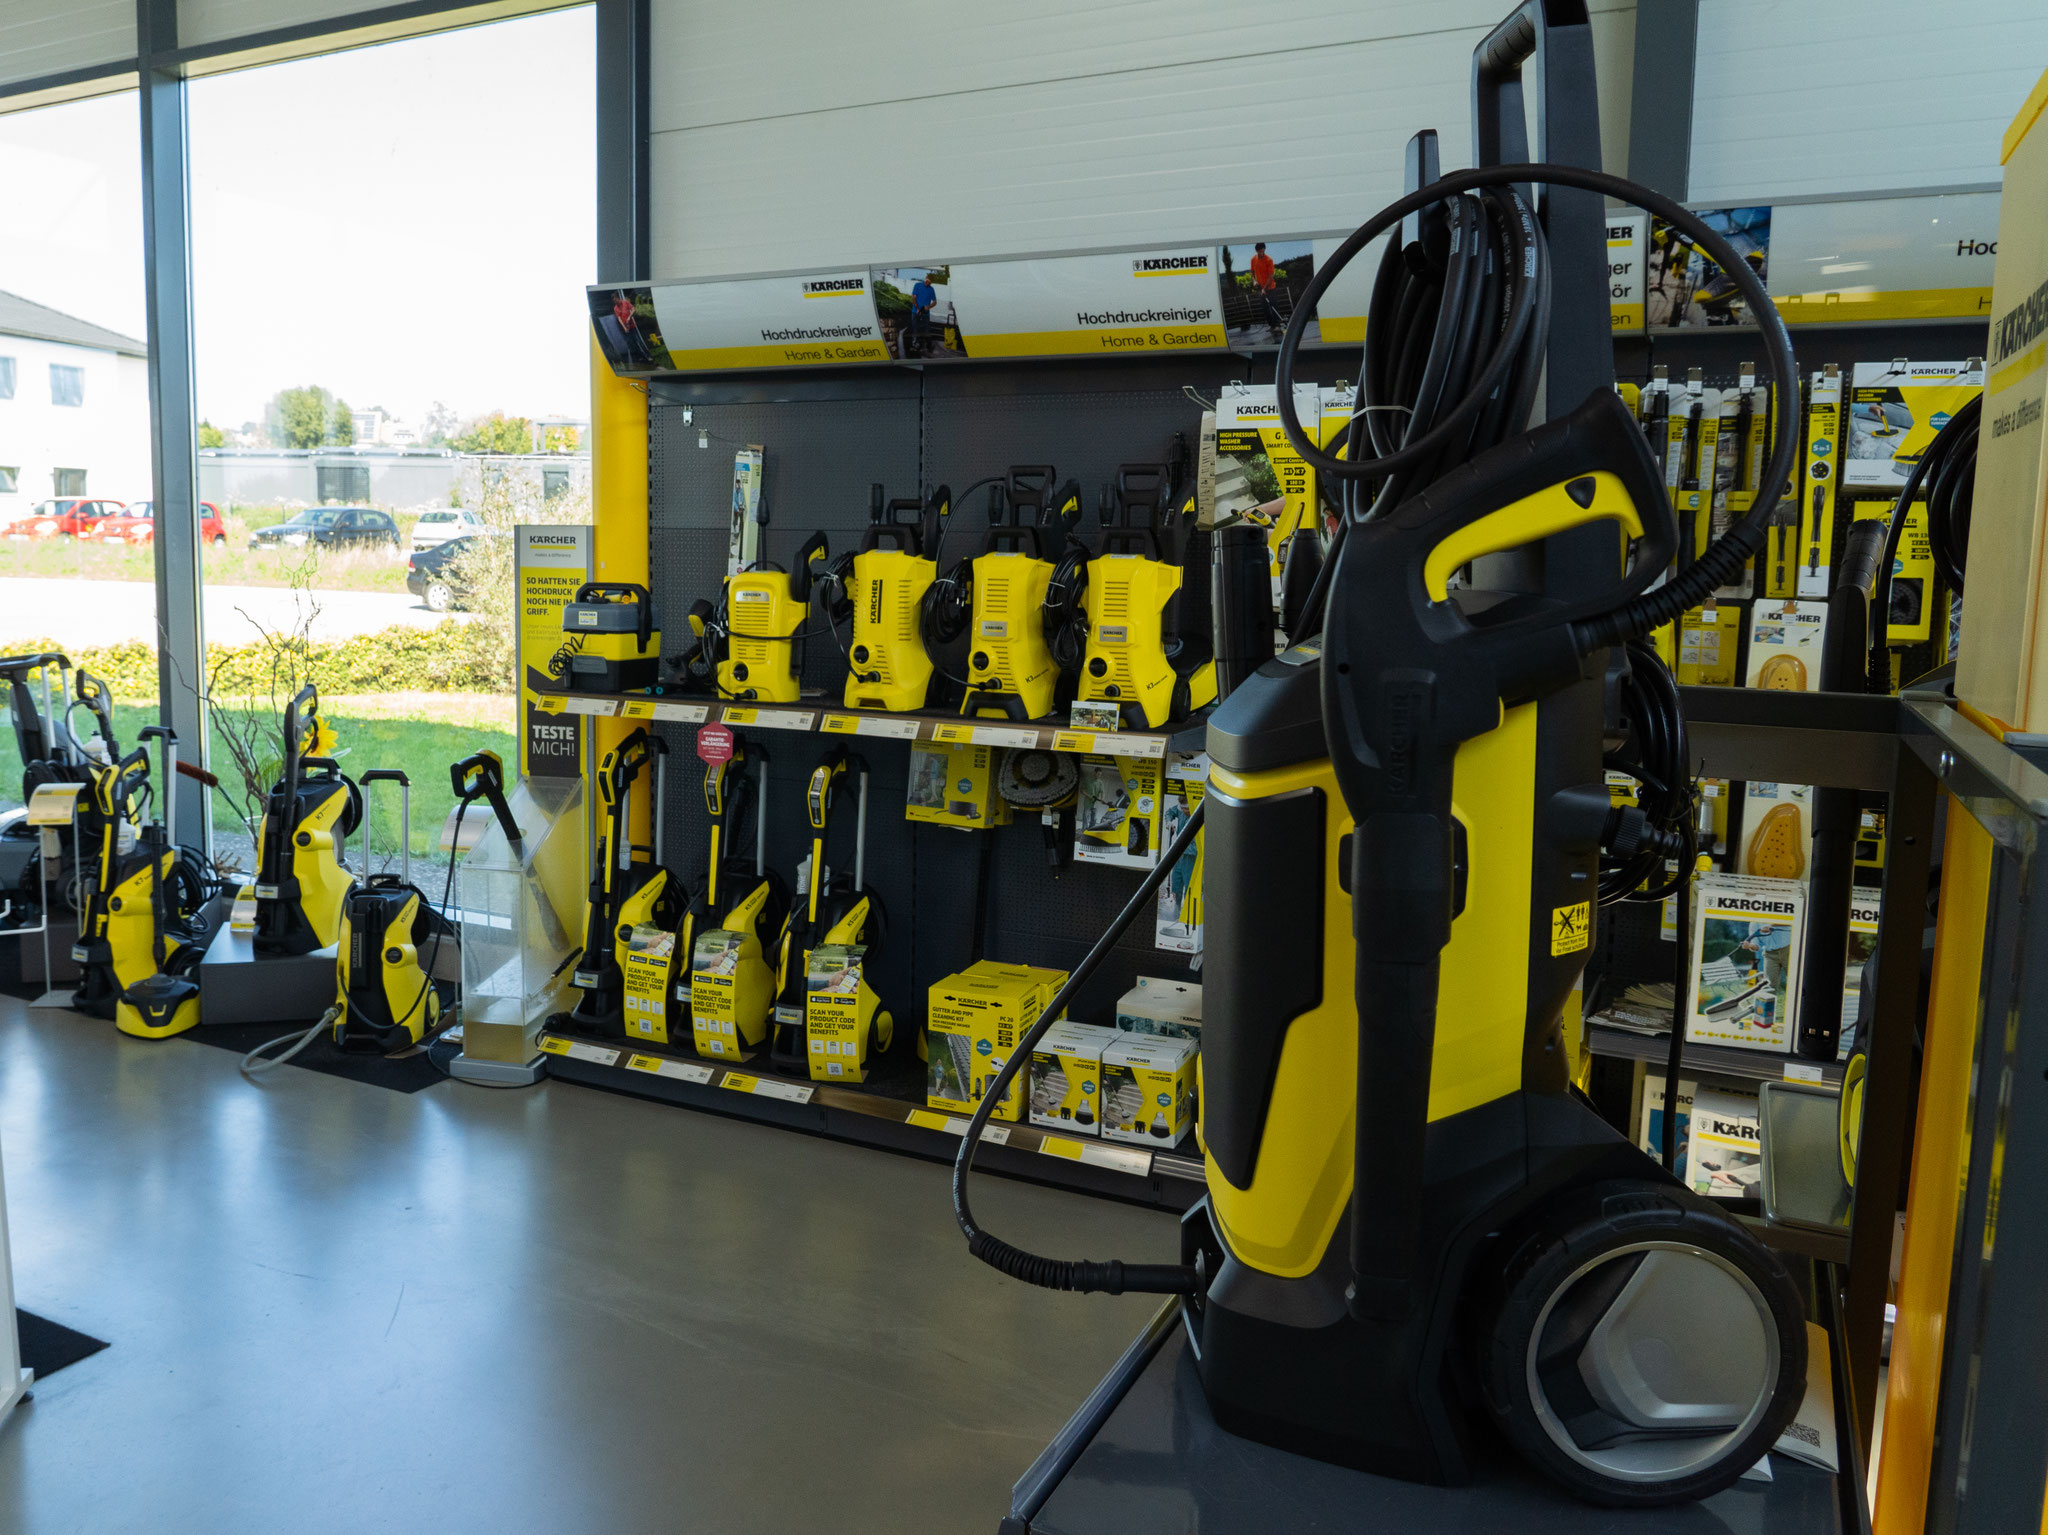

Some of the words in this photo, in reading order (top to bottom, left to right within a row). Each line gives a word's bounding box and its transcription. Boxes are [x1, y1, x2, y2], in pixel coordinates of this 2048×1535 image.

[1143, 254, 1208, 270] KÄRCHER
[810, 278, 864, 292] KÄRCHER
[1077, 306, 1213, 325] Hochdruckreiniger
[761, 324, 873, 342] Hochdruckreiniger
[1101, 334, 1145, 348] Home
[1148, 333, 1160, 345] &
[1163, 331, 1217, 345] Garden
[784, 349, 821, 361] Home
[824, 348, 834, 360] &
[836, 346, 881, 360] Garden
[1910, 367, 1956, 375] KÄRCHER
[1236, 404, 1280, 415] KÄRCH
[1324, 401, 1355, 409] KÄRCHE
[529, 535, 577, 544] KÄRCHER
[526, 577, 536, 585] SO
[537, 577, 567, 586] HATTEN
[569, 577, 581, 586] SIE
[526, 587, 572, 596] HOCHDRUCK
[526, 598, 548, 606] NOCH
[549, 598, 562, 606] NIE
[869, 578, 879, 625] KÄRCHER
[526, 608, 550, 616] GRIFF.
[1767, 612, 1821, 624] KÄCHER
[532, 725, 575, 741] TESTE
[532, 741, 575, 756] MICH!
[1717, 896, 1795, 914] KÄRCHER
[627, 966, 643, 974] SCAN
[642, 969, 657, 977] YOUR
[627, 972, 650, 983] PRODUCT
[650, 977, 664, 985] CODE
[626, 979, 638, 987] AND
[649, 983, 664, 991] YOUR
[626, 985, 650, 994] BENEFITS
[693, 987, 708, 995] SCAN
[708, 989, 723, 997] YOUR
[693, 994, 717, 1003] PRODUCT
[718, 997, 732, 1005] CODE
[957, 997, 987, 1006] KÄRCHER
[693, 1006, 718, 1015] BENEFITS
[716, 1003, 731, 1011] YOUR
[932, 1006, 952, 1014] GUTTER
[827, 1009, 844, 1017] YOUR
[932, 1012, 956, 1021] CLEANING
[837, 1023, 855, 1031] YOUR
